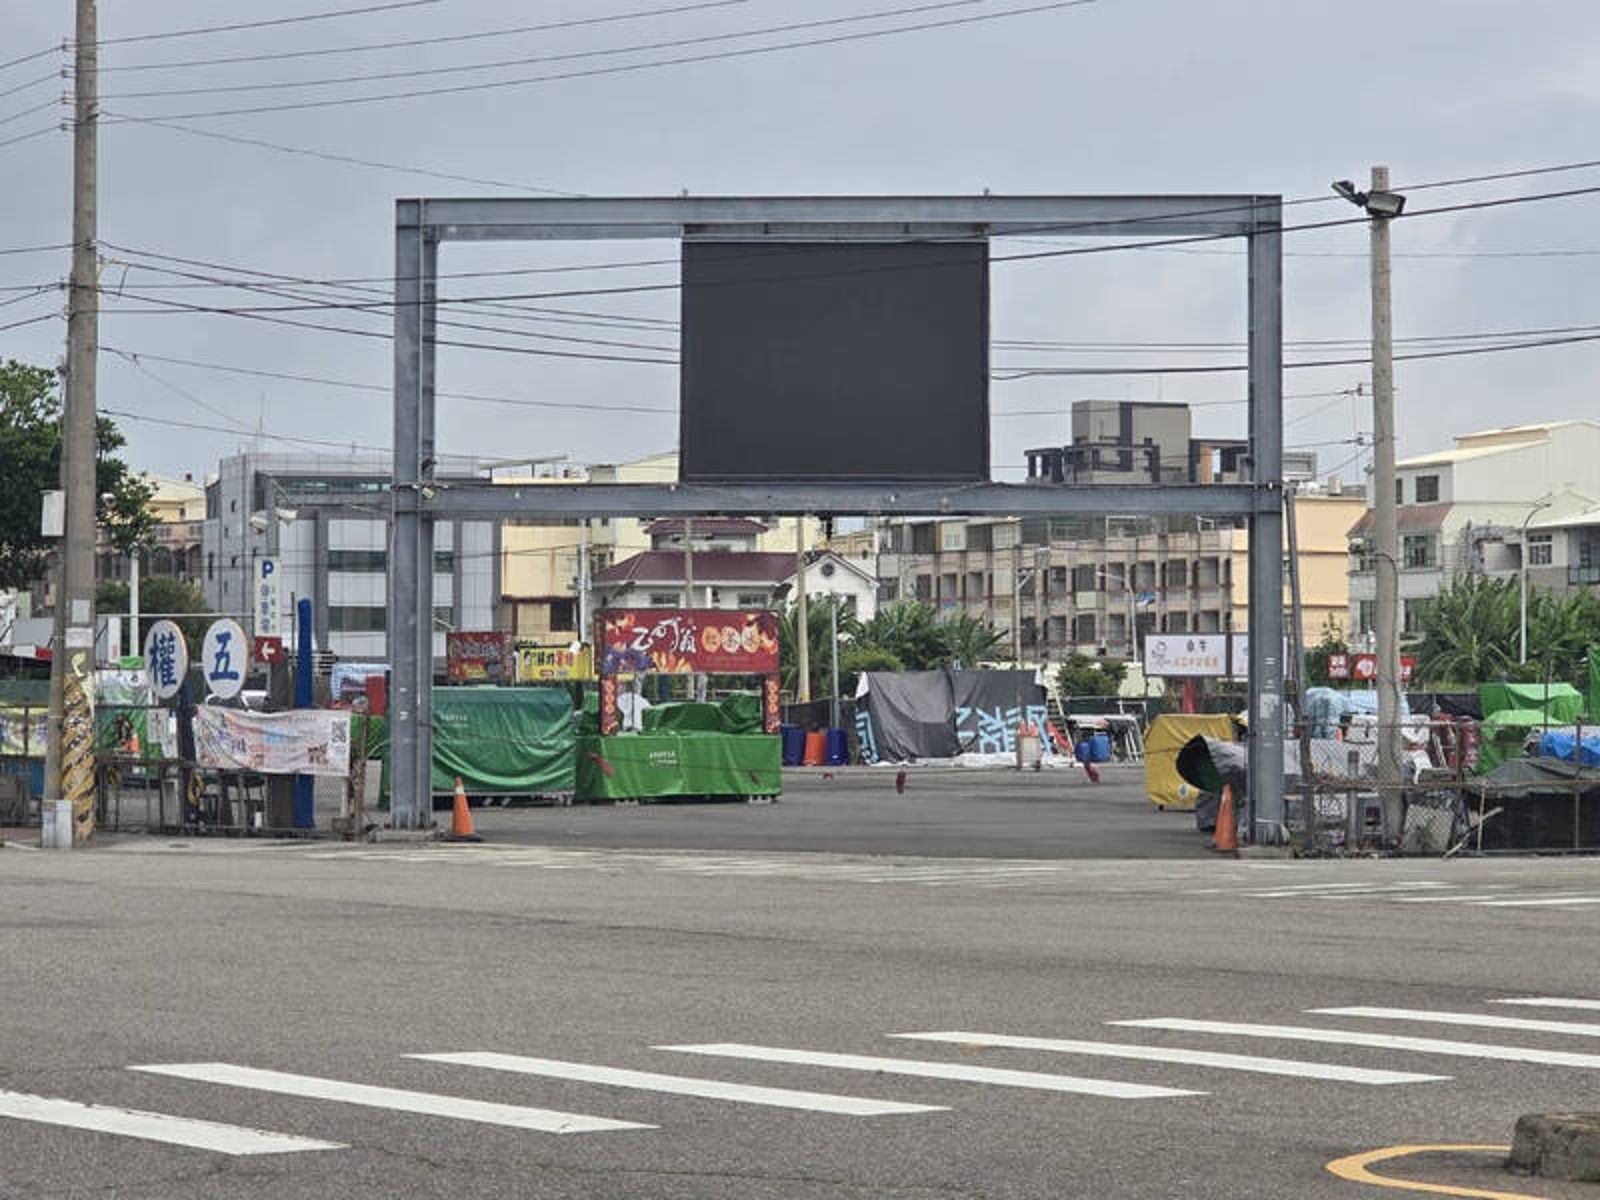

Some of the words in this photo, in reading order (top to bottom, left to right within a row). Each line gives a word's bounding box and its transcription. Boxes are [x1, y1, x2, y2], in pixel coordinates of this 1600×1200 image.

[262, 560, 274, 579] P
[149, 631, 177, 688] 權
[209, 631, 240, 681] 五
